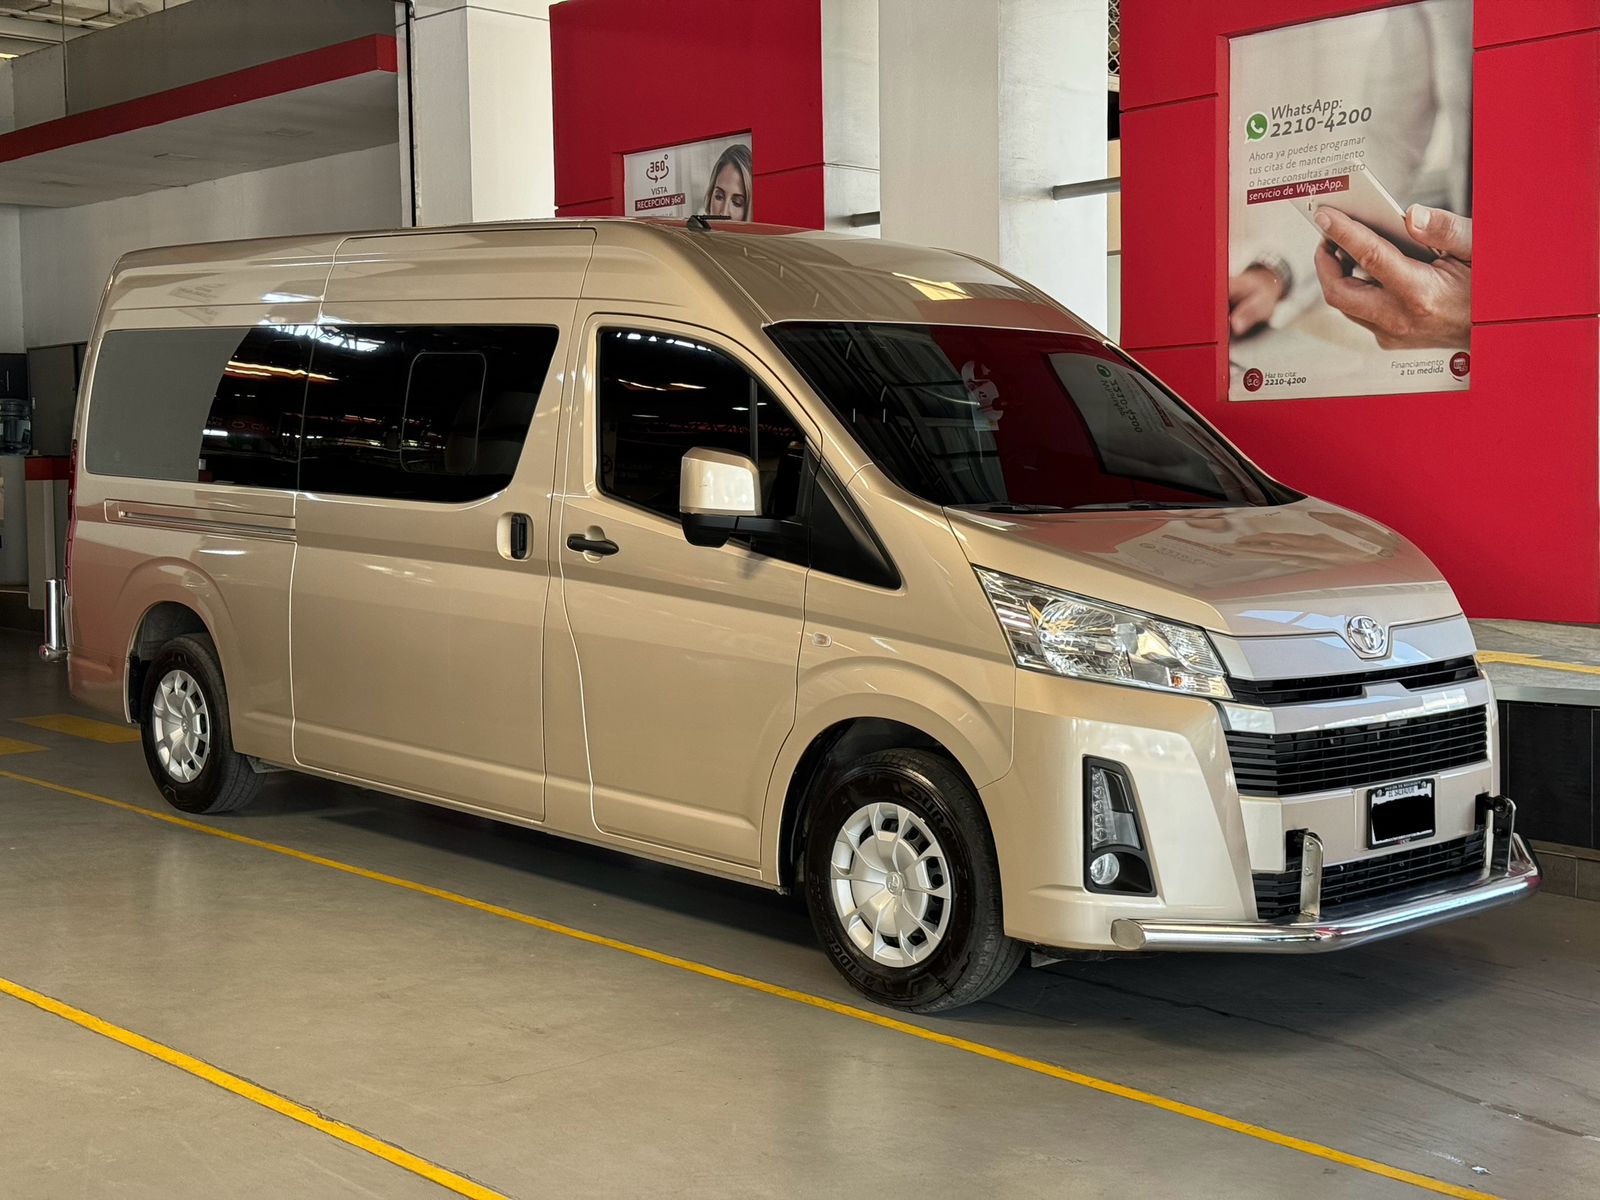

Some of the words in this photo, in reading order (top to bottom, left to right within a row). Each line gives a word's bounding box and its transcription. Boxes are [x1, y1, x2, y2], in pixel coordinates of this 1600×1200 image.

[1271, 99, 1343, 120] WhatsApp:
[1270, 107, 1372, 138] 2210-4200
[1249, 151, 1274, 162] Ahora
[1276, 151, 1286, 159] ya
[1287, 143, 1318, 158] puedes
[1320, 136, 1366, 155] programar
[1249, 166, 1262, 175] tus
[1264, 162, 1284, 173] citas
[1286, 160, 1297, 169] de
[1299, 149, 1365, 167] mantenimiento
[1257, 176, 1280, 187] hacer
[1282, 170, 1322, 183] consultas
[1331, 163, 1366, 175] nuestro
[651, 186, 668, 196] VISTA
[1249, 189, 1281, 201] servicio
[1283, 186, 1294, 195] de
[1296, 179, 1344, 194] WhatsApp.
[1391, 359, 1445, 369] Financiamiento
[1417, 365, 1444, 374] medida
[1264, 376, 1307, 387] 2210-4200
